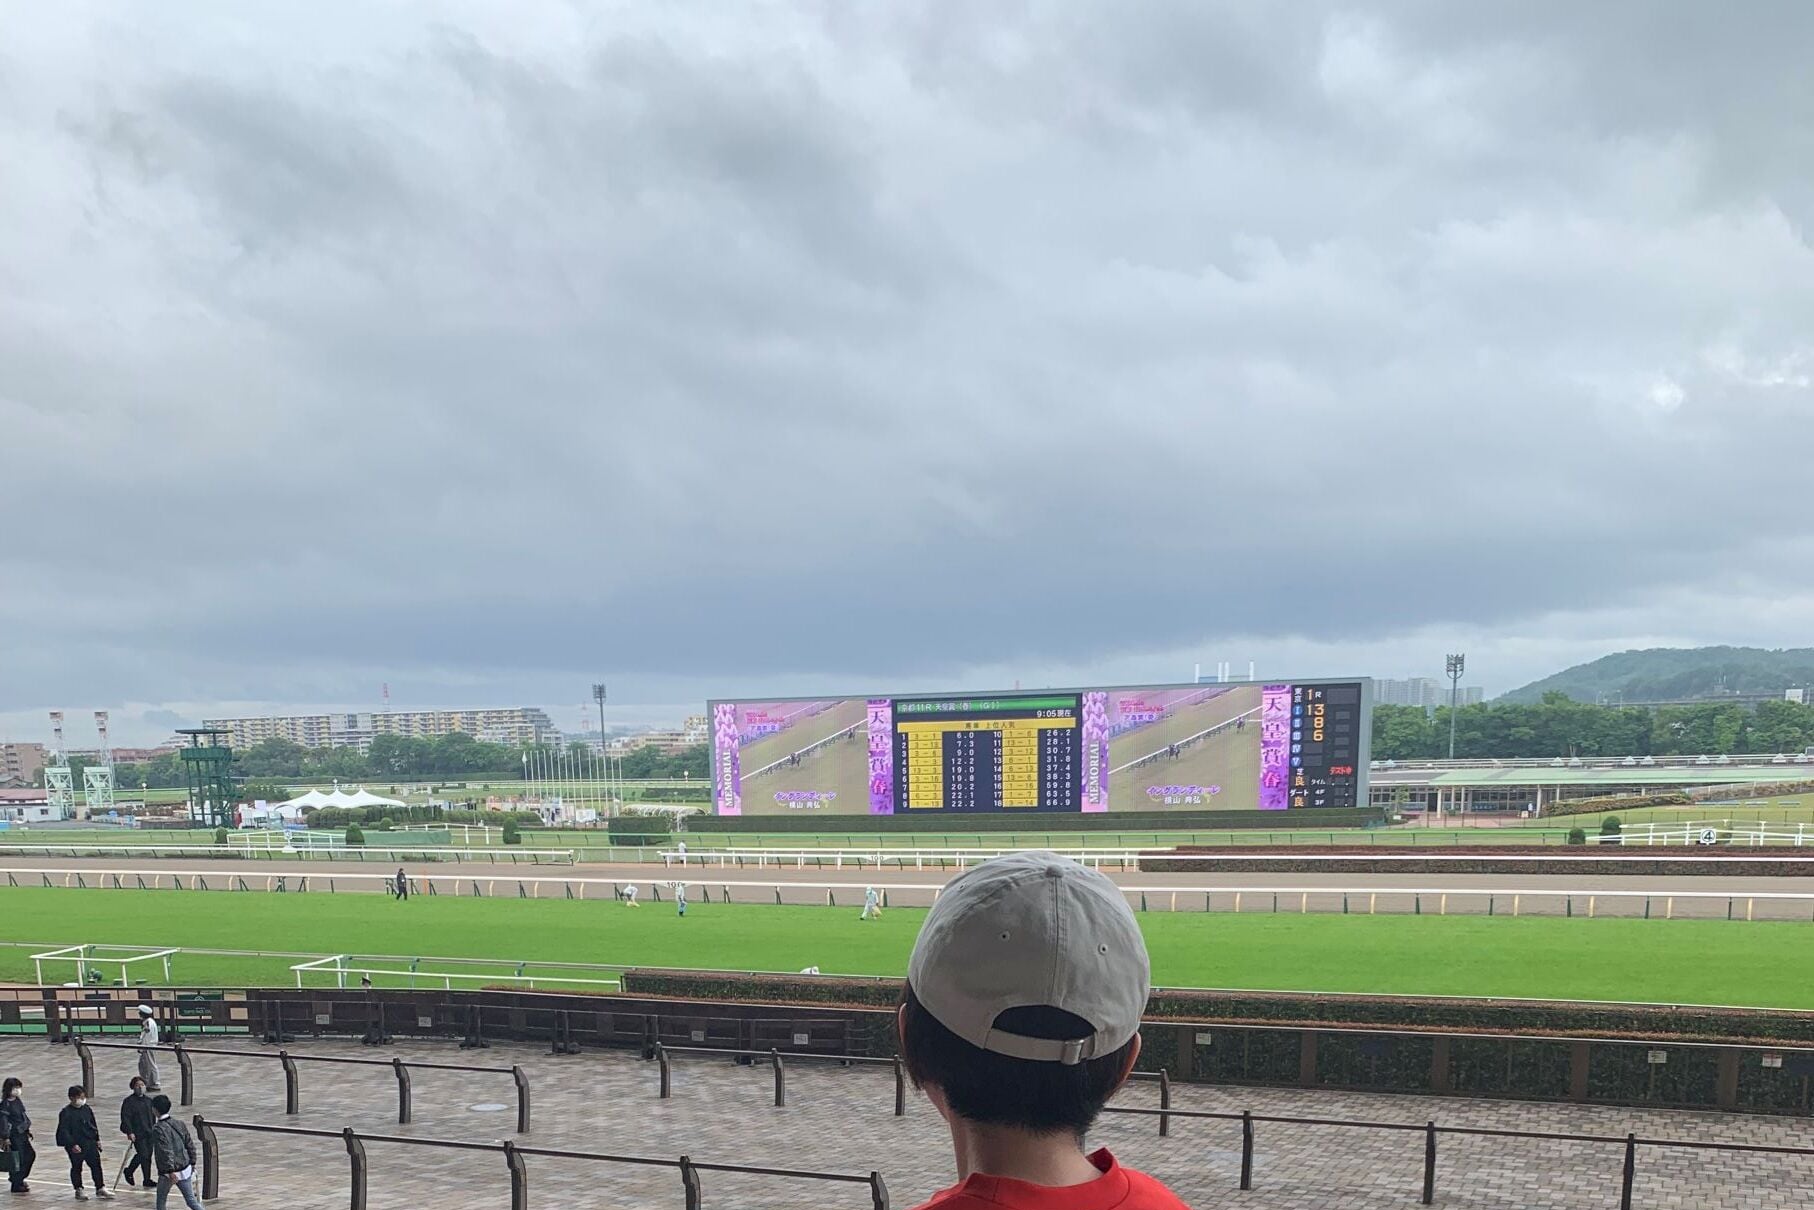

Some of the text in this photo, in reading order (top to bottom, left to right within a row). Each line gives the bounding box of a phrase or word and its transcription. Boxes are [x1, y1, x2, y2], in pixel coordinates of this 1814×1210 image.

[1294, 688, 1302, 702] 東京
[1307, 704, 1325, 716] 13
[1314, 716, 1324, 728] 8
[1313, 730, 1323, 741] 6
[723, 749, 733, 807] MEMORIAL
[1089, 742, 1099, 803] MEMORIAL
[1295, 776, 1305, 786] 良
[1294, 797, 1304, 807] 良
